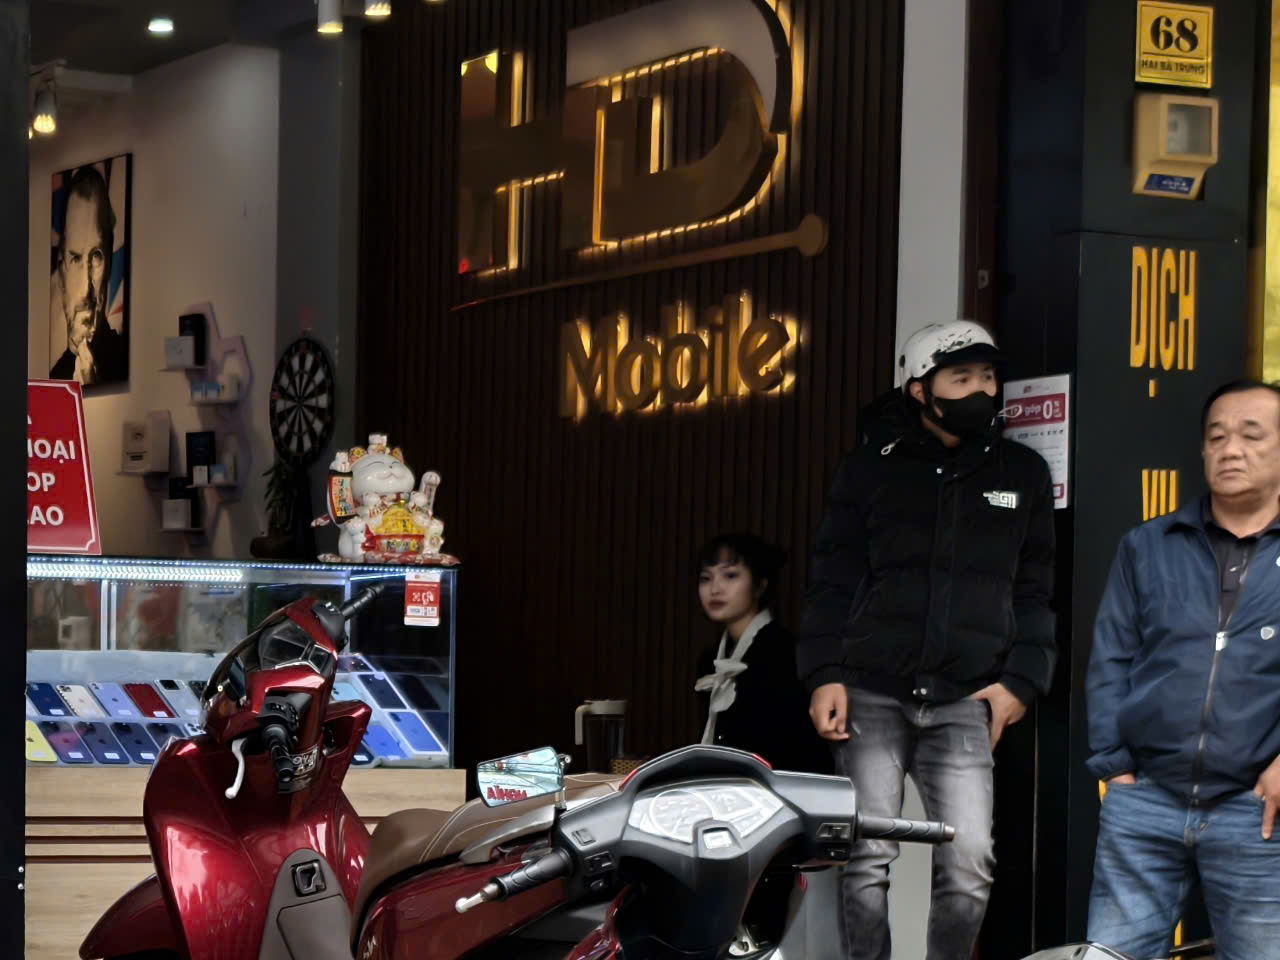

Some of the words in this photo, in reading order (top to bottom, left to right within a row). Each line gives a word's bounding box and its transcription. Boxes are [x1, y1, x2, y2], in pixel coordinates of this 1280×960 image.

[1150, 15, 1199, 53] 68
[561, 292, 793, 424] Mobile
[1130, 246, 1197, 398] DỊCH
